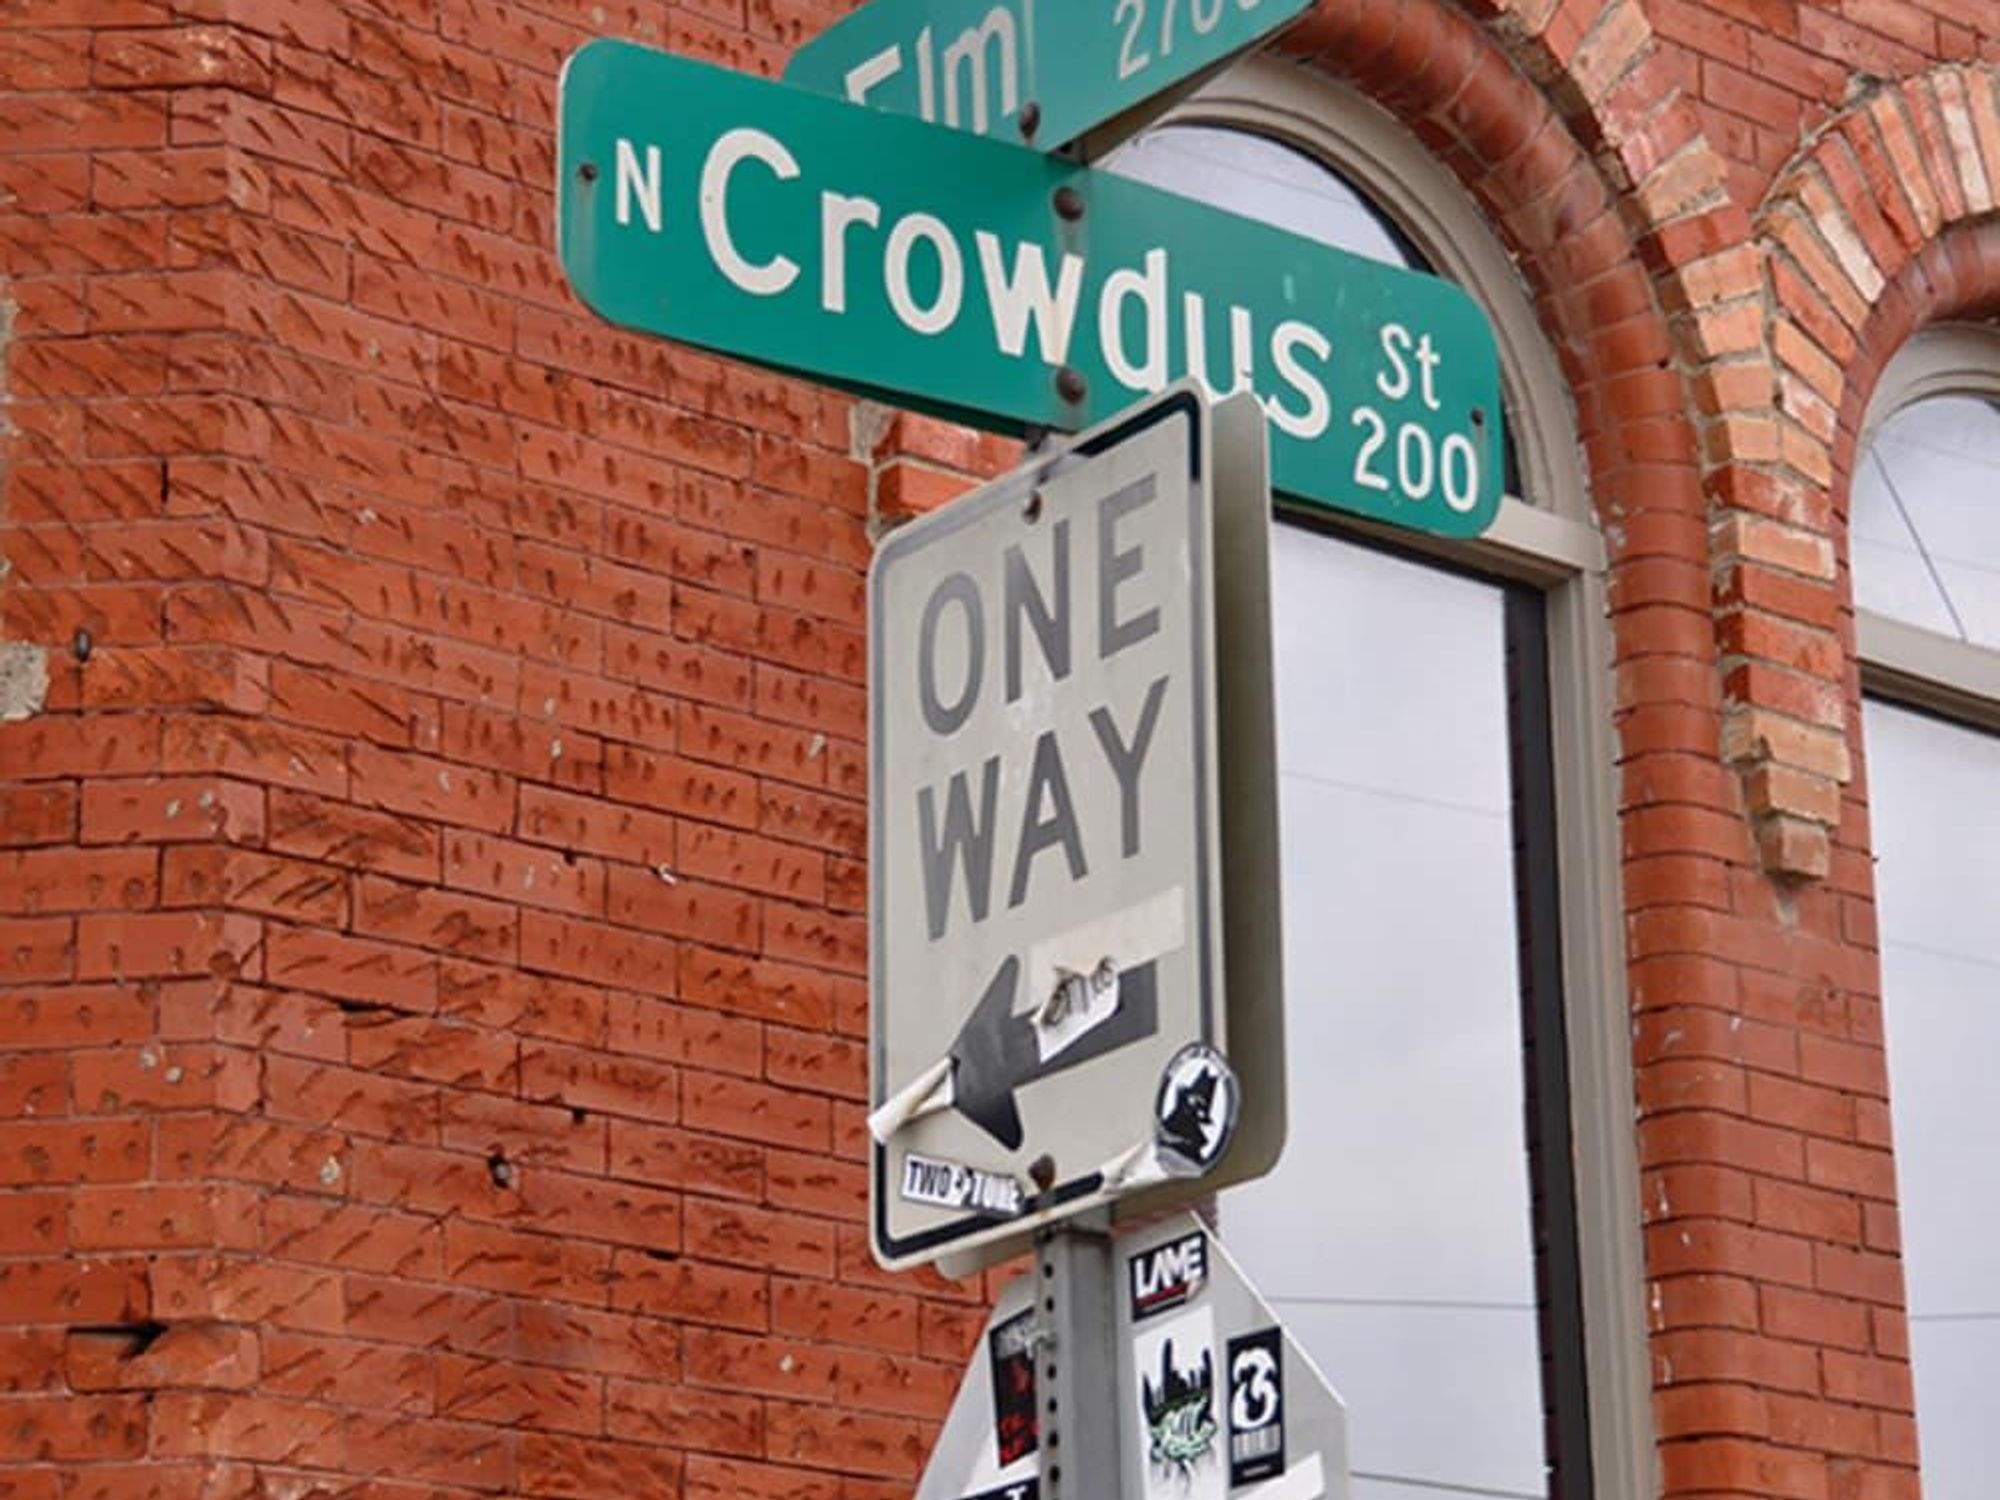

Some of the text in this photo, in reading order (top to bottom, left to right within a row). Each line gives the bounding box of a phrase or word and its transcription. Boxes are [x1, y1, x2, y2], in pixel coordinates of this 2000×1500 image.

[615, 127, 1441, 439] N Crowdus St
[1351, 405, 1478, 513] 200
[917, 471, 1160, 736] ONE
[916, 675, 1170, 943] WAY
[1135, 1236, 1202, 1299] LAME
